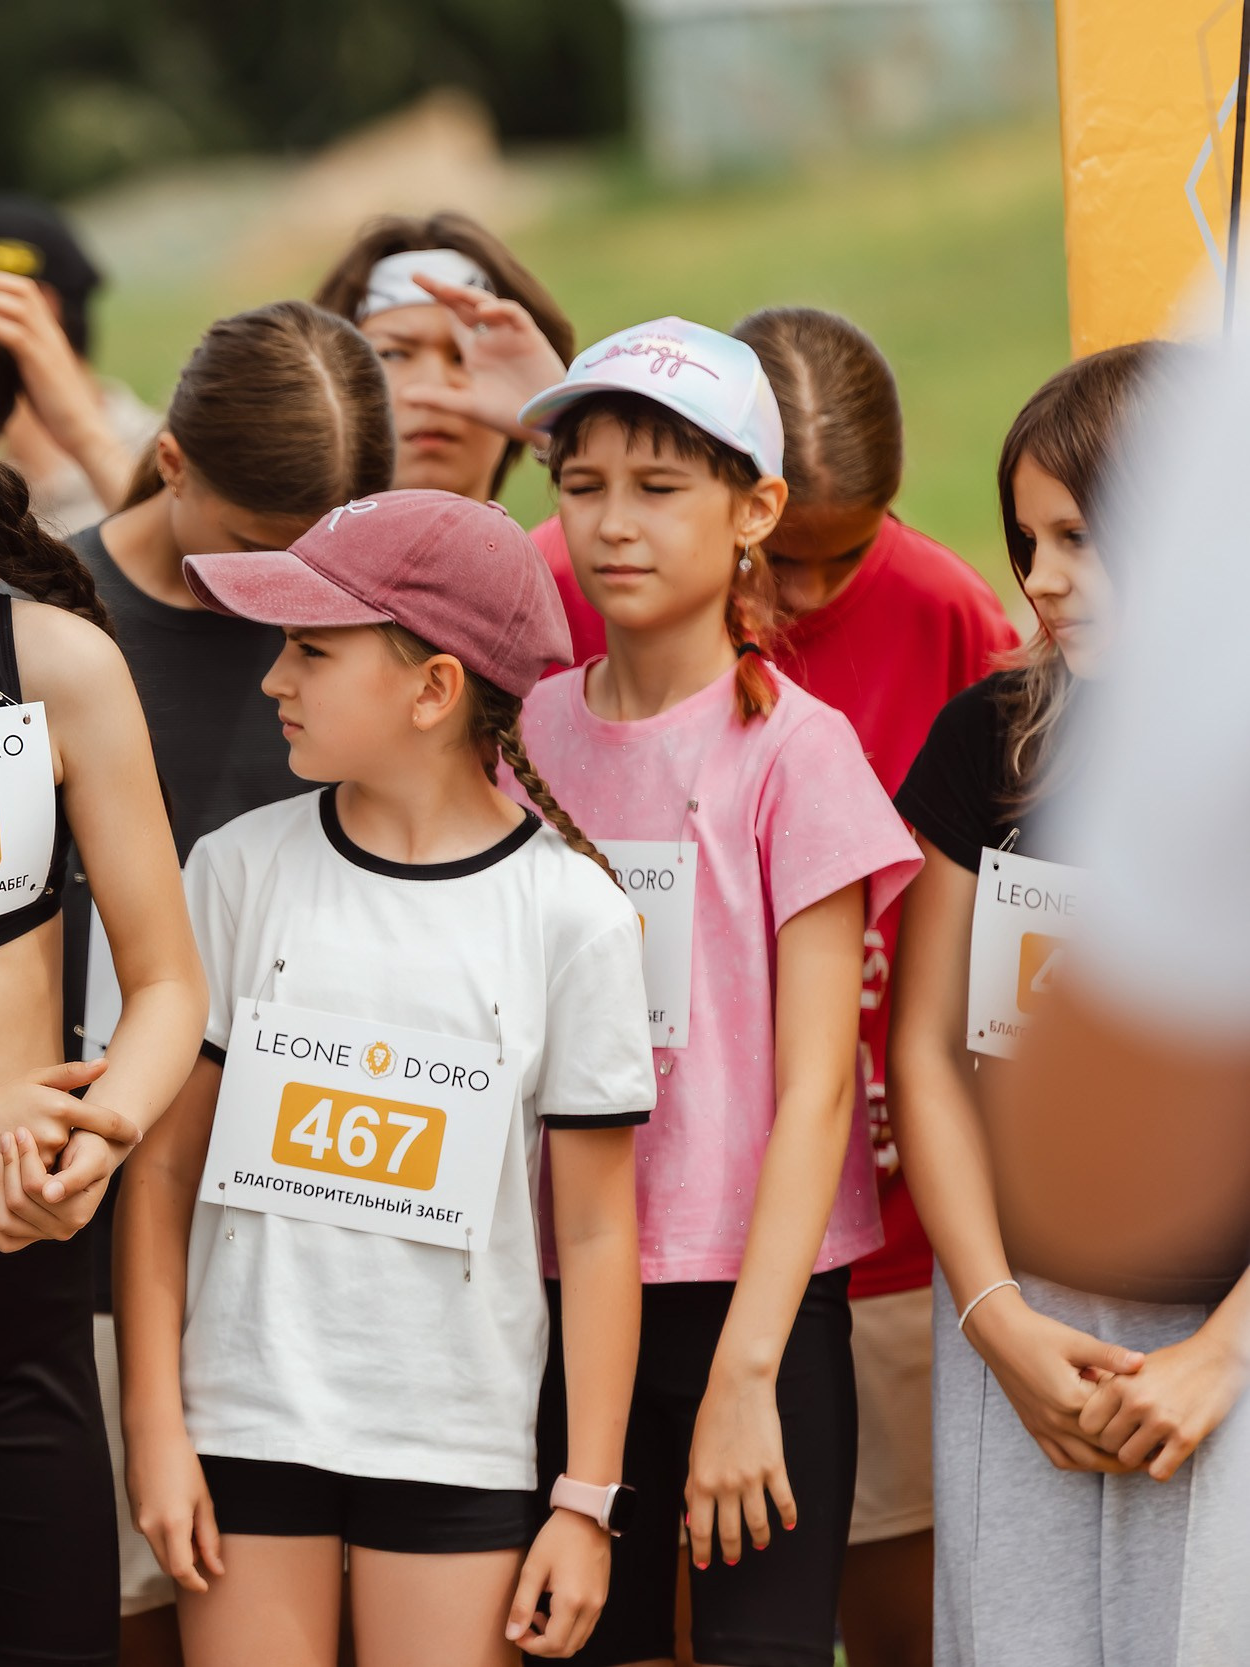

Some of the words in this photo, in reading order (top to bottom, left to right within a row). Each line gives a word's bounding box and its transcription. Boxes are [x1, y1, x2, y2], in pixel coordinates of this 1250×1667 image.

[996, 880, 1078, 917] LEONE
[255, 1029, 352, 1067] LEONE
[403, 1056, 490, 1091] D'ORO
[289, 1097, 428, 1175] 467
[233, 1170, 412, 1215] БЛАГОТВОРИТЕЛЬНЫЙ
[415, 1204, 464, 1224] ЗАБЕГ
